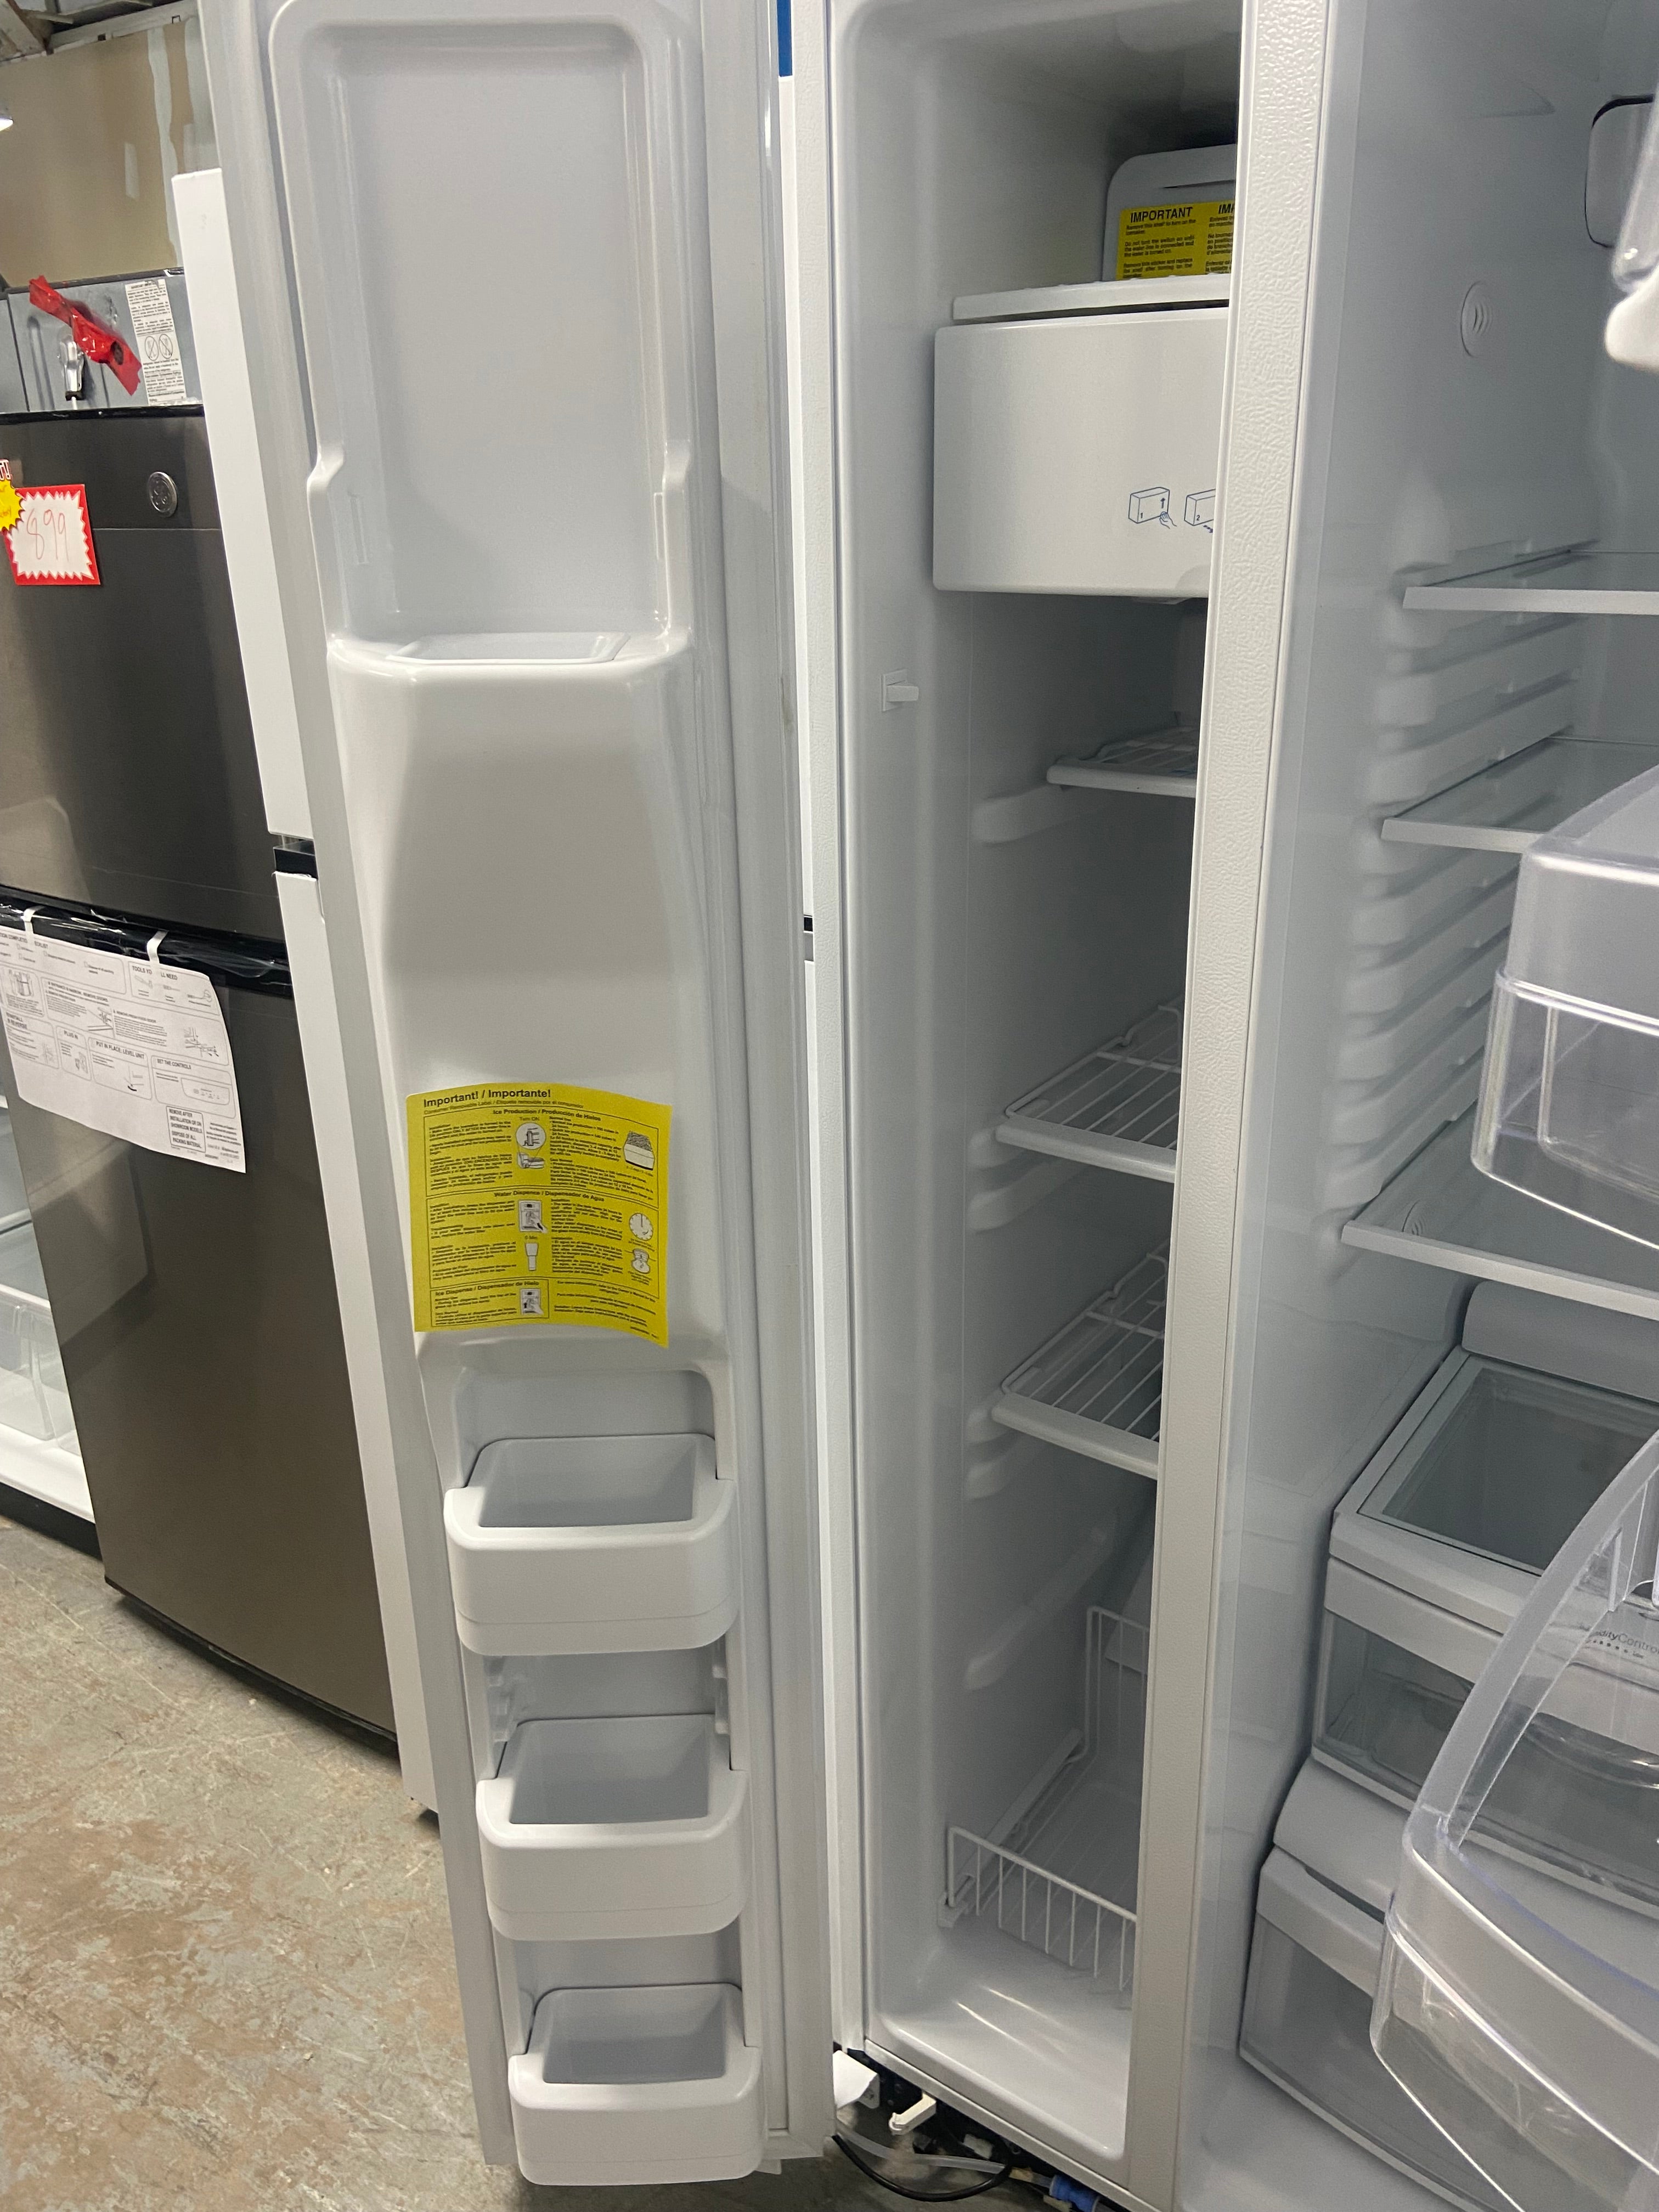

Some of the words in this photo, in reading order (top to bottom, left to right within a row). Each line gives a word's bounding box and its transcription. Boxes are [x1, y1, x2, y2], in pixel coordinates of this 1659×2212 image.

[1130, 207, 1193, 223] IMPORTANT
[26, 508, 69, 562] 899
[132, 966, 145, 974] TOOLS
[123, 1049, 135, 1057] LEVEL
[172, 1061, 191, 1070] CONTROLS
[424, 1090, 478, 1107] Important!
[488, 1089, 551, 1099] Importante!
